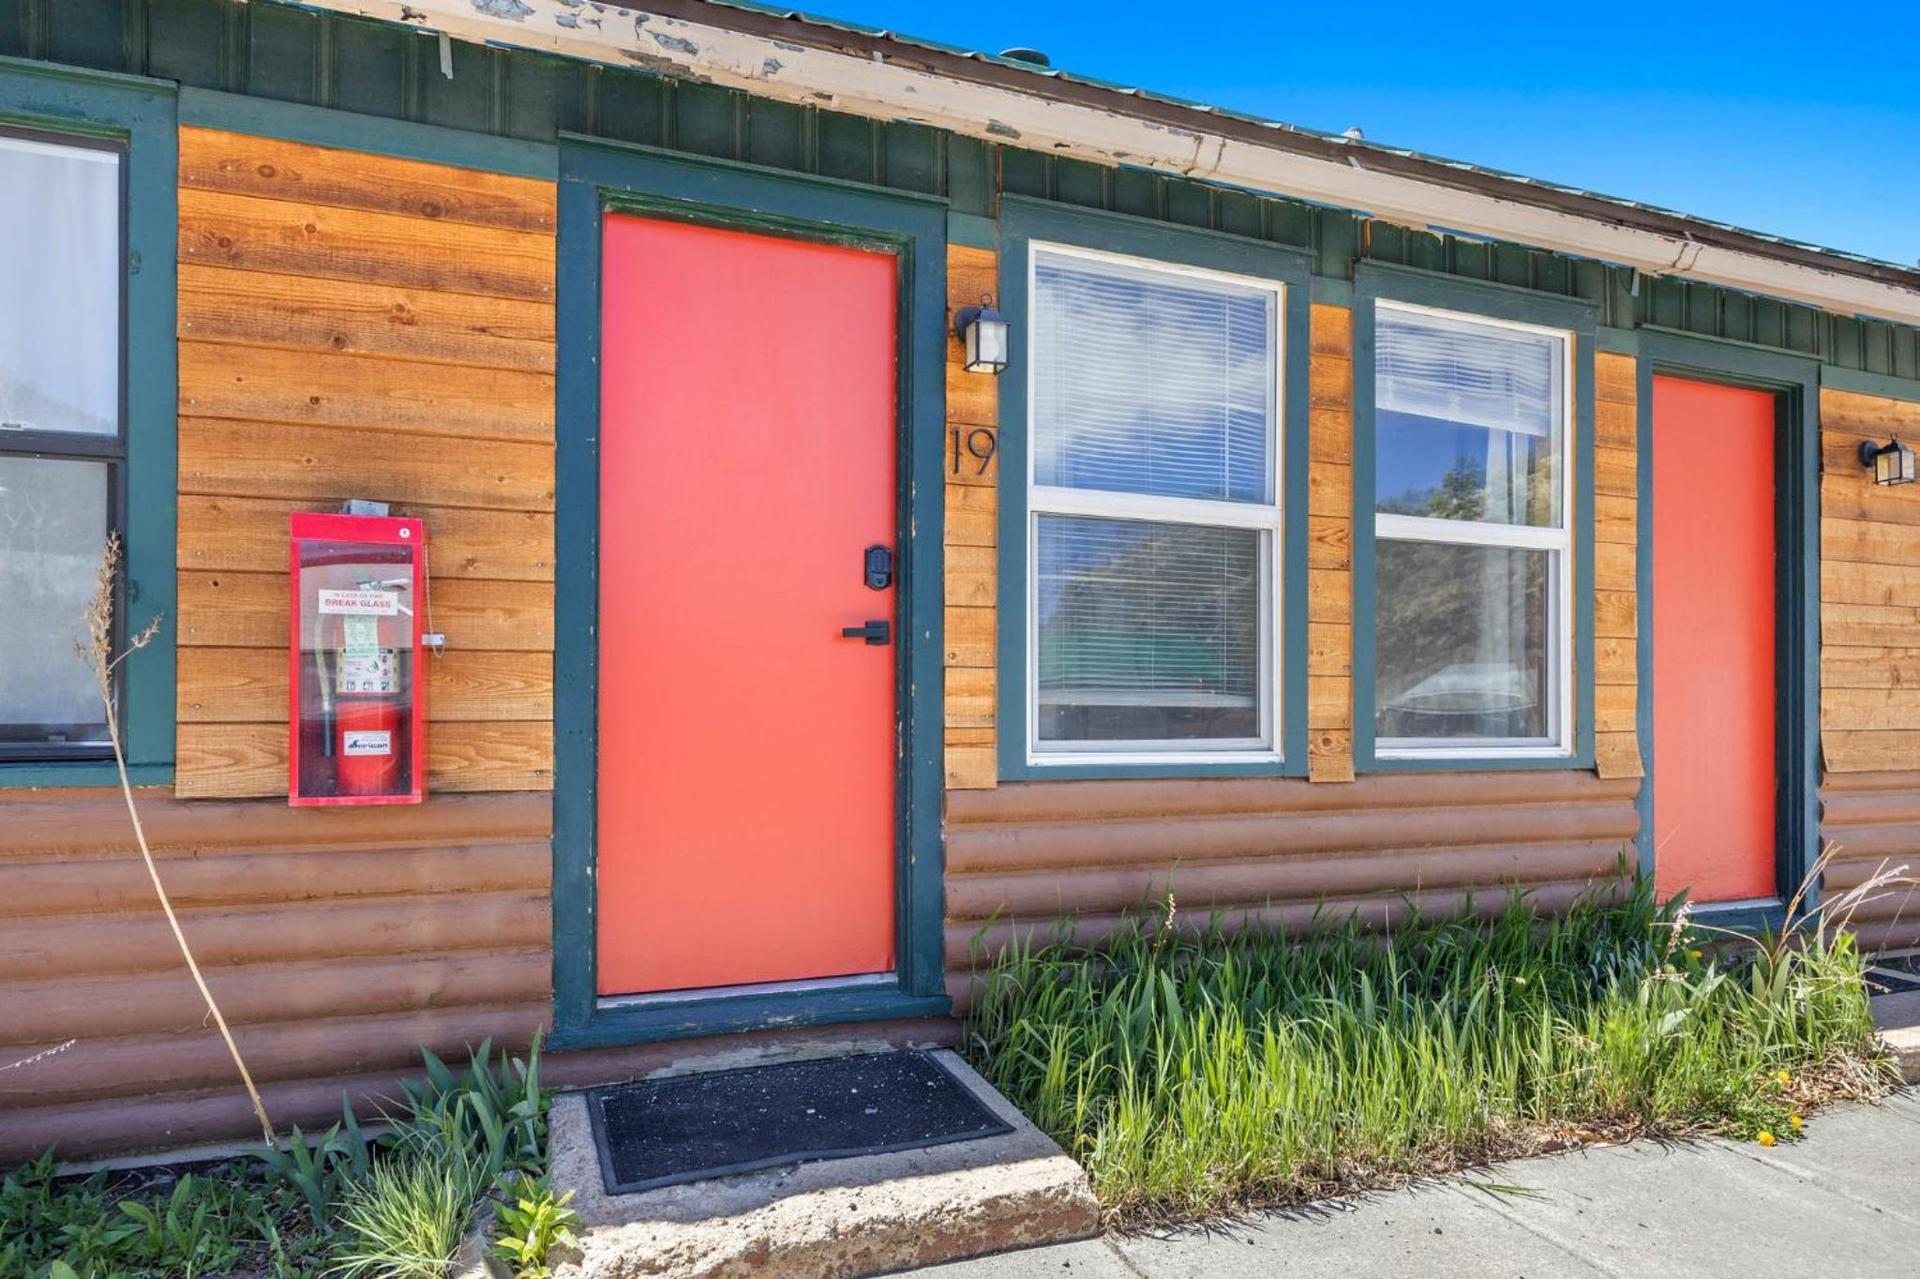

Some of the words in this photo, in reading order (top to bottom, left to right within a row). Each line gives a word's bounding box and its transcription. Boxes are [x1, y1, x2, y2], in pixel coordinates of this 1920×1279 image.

[953, 428, 996, 476] 19
[325, 599, 358, 607] BREAK
[360, 600, 392, 608] GLASS
